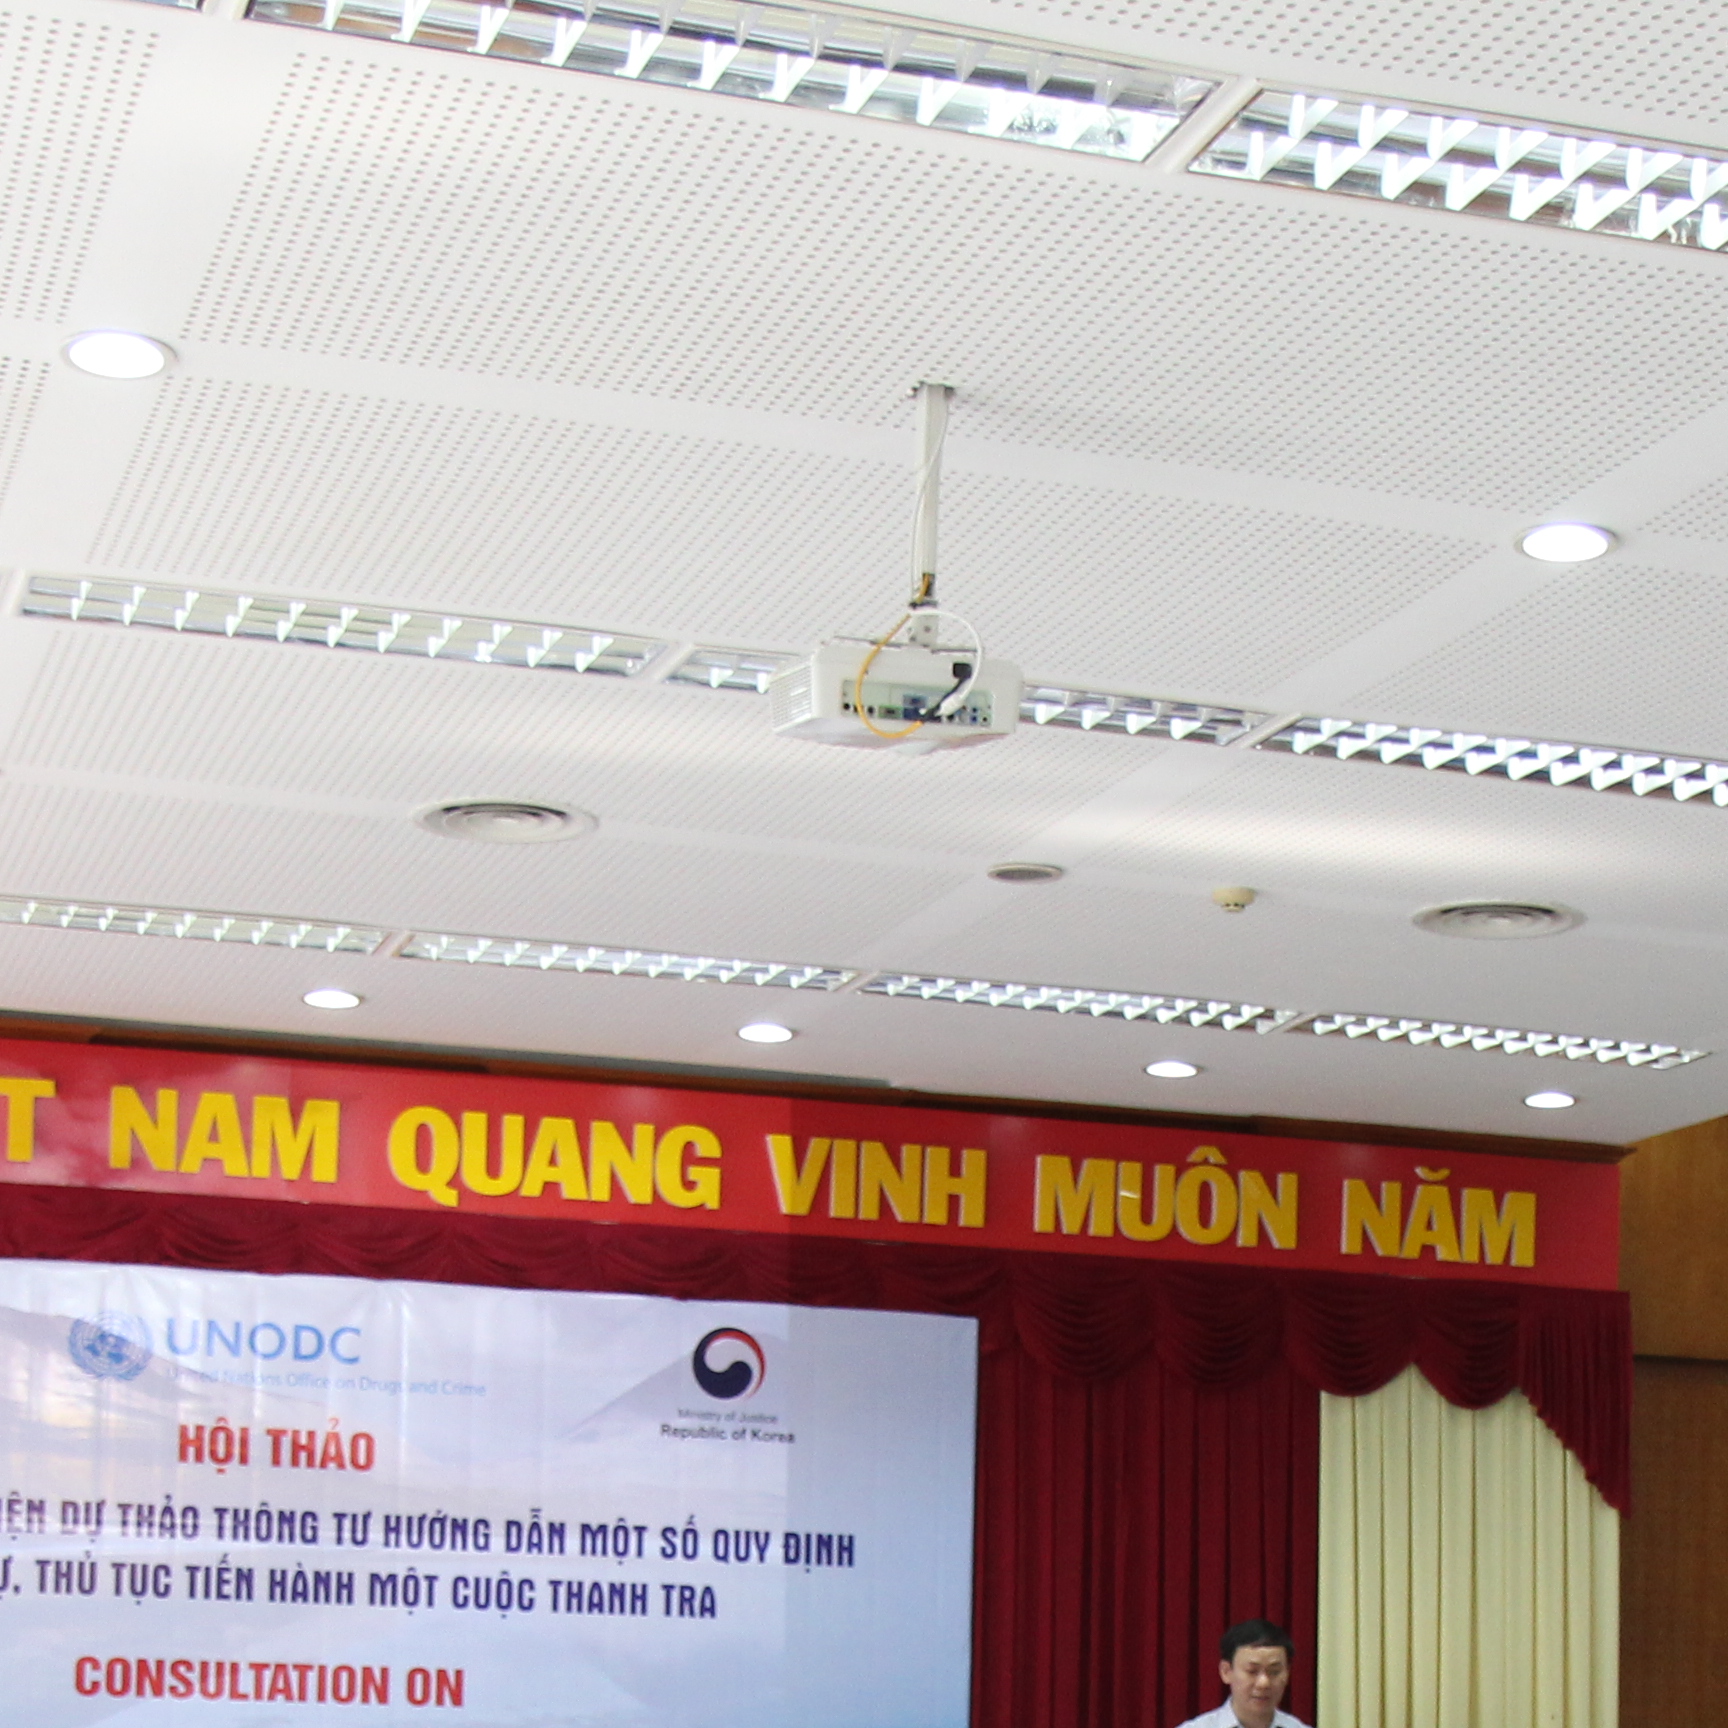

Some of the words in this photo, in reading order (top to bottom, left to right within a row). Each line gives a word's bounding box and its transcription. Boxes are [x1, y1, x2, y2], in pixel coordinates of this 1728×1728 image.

[108, 1085, 340, 1184] NAM
[387, 1104, 721, 1209] QUANG
[766, 1134, 986, 1230] VINH
[1033, 1146, 1298, 1251] MUÔN
[1339, 1167, 1536, 1269] NĂM
[166, 1318, 362, 1365] UNODC
[178, 1415, 249, 1474] HỘI
[266, 1417, 374, 1473] THẢO
[661, 1424, 727, 1441] Republic
[731, 1427, 747, 1440] of
[751, 1429, 795, 1443] Korea
[61, 1498, 108, 1543] DỰ
[117, 1492, 200, 1542] THẢO
[213, 1497, 319, 1547] THÔNG
[332, 1510, 374, 1550] TƯ
[383, 1506, 492, 1553] HƯỚNG
[505, 1507, 567, 1557] DẪN
[580, 1514, 648, 1566] MỘT
[659, 1513, 700, 1562] SỐ
[712, 1527, 771, 1567] QUY
[782, 1530, 856, 1575] ĐỊNH
[35, 1550, 98, 1598] THỦ
[112, 1560, 172, 1606] TỤC
[185, 1550, 255, 1602] TIẾN
[270, 1561, 355, 1607] HÀNH
[369, 1570, 440, 1617] MỘT
[451, 1570, 536, 1618] CUỘC
[548, 1579, 649, 1619] THANH
[662, 1583, 718, 1620] TRA
[74, 1655, 390, 1706] CONSULTATION
[405, 1667, 465, 1708] ON
